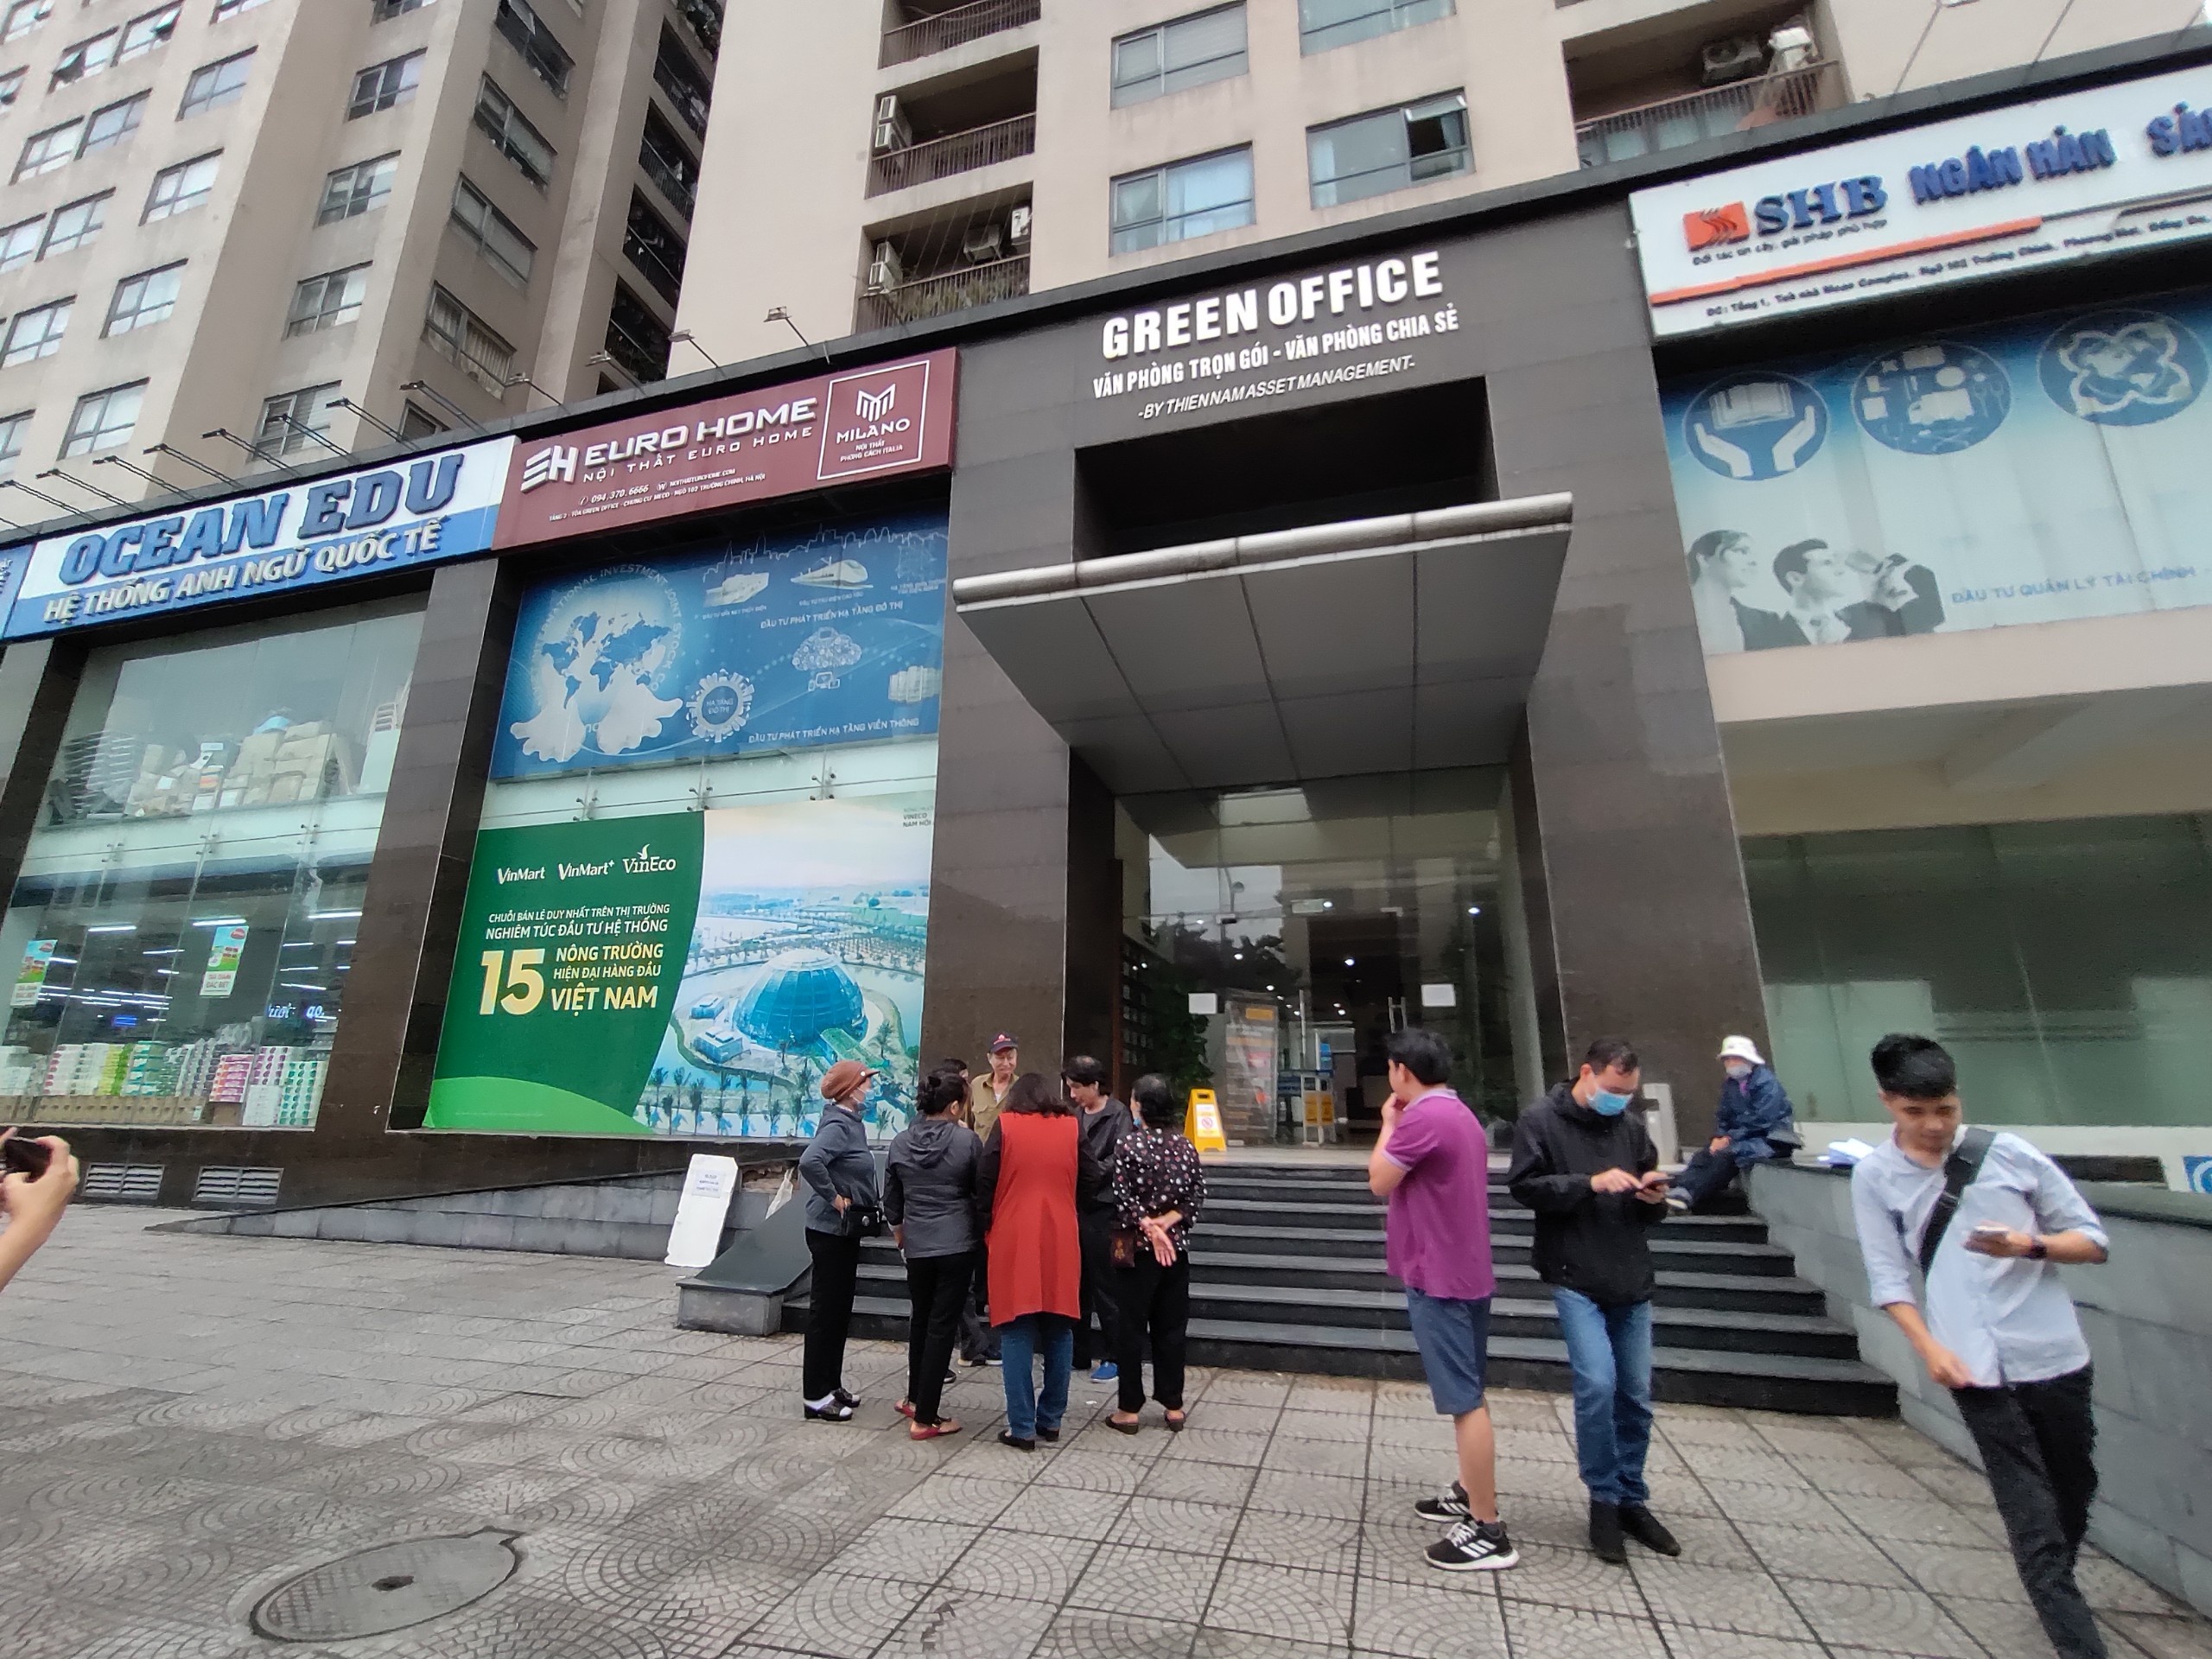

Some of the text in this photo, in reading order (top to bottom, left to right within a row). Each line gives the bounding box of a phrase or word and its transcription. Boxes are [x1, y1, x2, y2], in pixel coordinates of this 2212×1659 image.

[1752, 175, 1890, 236] SHB
[1909, 144, 2024, 205] NGÂN
[1102, 251, 1444, 360] GREEN OFFICE
[1092, 372, 1124, 400] VĂN
[1127, 359, 1184, 394] PHÒNG
[1189, 351, 1236, 383] TRỌN
[1239, 341, 1270, 370] GÓI
[1284, 334, 1320, 362] VĂN
[1322, 321, 1383, 354] PHÒNG
[1386, 314, 1431, 344] CHIA
[1434, 302, 1460, 334] SẺ
[1244, 375, 1297, 399] ASSET
[583, 423, 690, 467] EURO
[696, 397, 818, 441] HOME
[836, 418, 911, 444] MILANO
[583, 425, 813, 484] NỘI THẤT EURO HOME
[591, 484, 649, 504] 094.370.6666
[59, 492, 290, 586] OCEAN
[297, 454, 464, 539] EDU
[44, 516, 448, 626] HỆ THỐNG ANH NGỮ QUỐC TẾ
[497, 867, 545, 885] VinMart
[622, 852, 677, 874] VinEco
[486, 915, 668, 940] NGHIÊM TÚC ĐẦU TƯ HỆ THỐNG
[488, 903, 671, 924] CHUỖI BÁN LẺ DUY NHẤT TRÊN THỊ TRƯỜNG
[556, 939, 664, 963] NÔNG TRƯỜNG
[479, 948, 546, 1016] 15
[553, 960, 662, 982] HIỆN ĐẠI HÀNG ĐẦU
[550, 982, 659, 1017] VIỆT NAM
